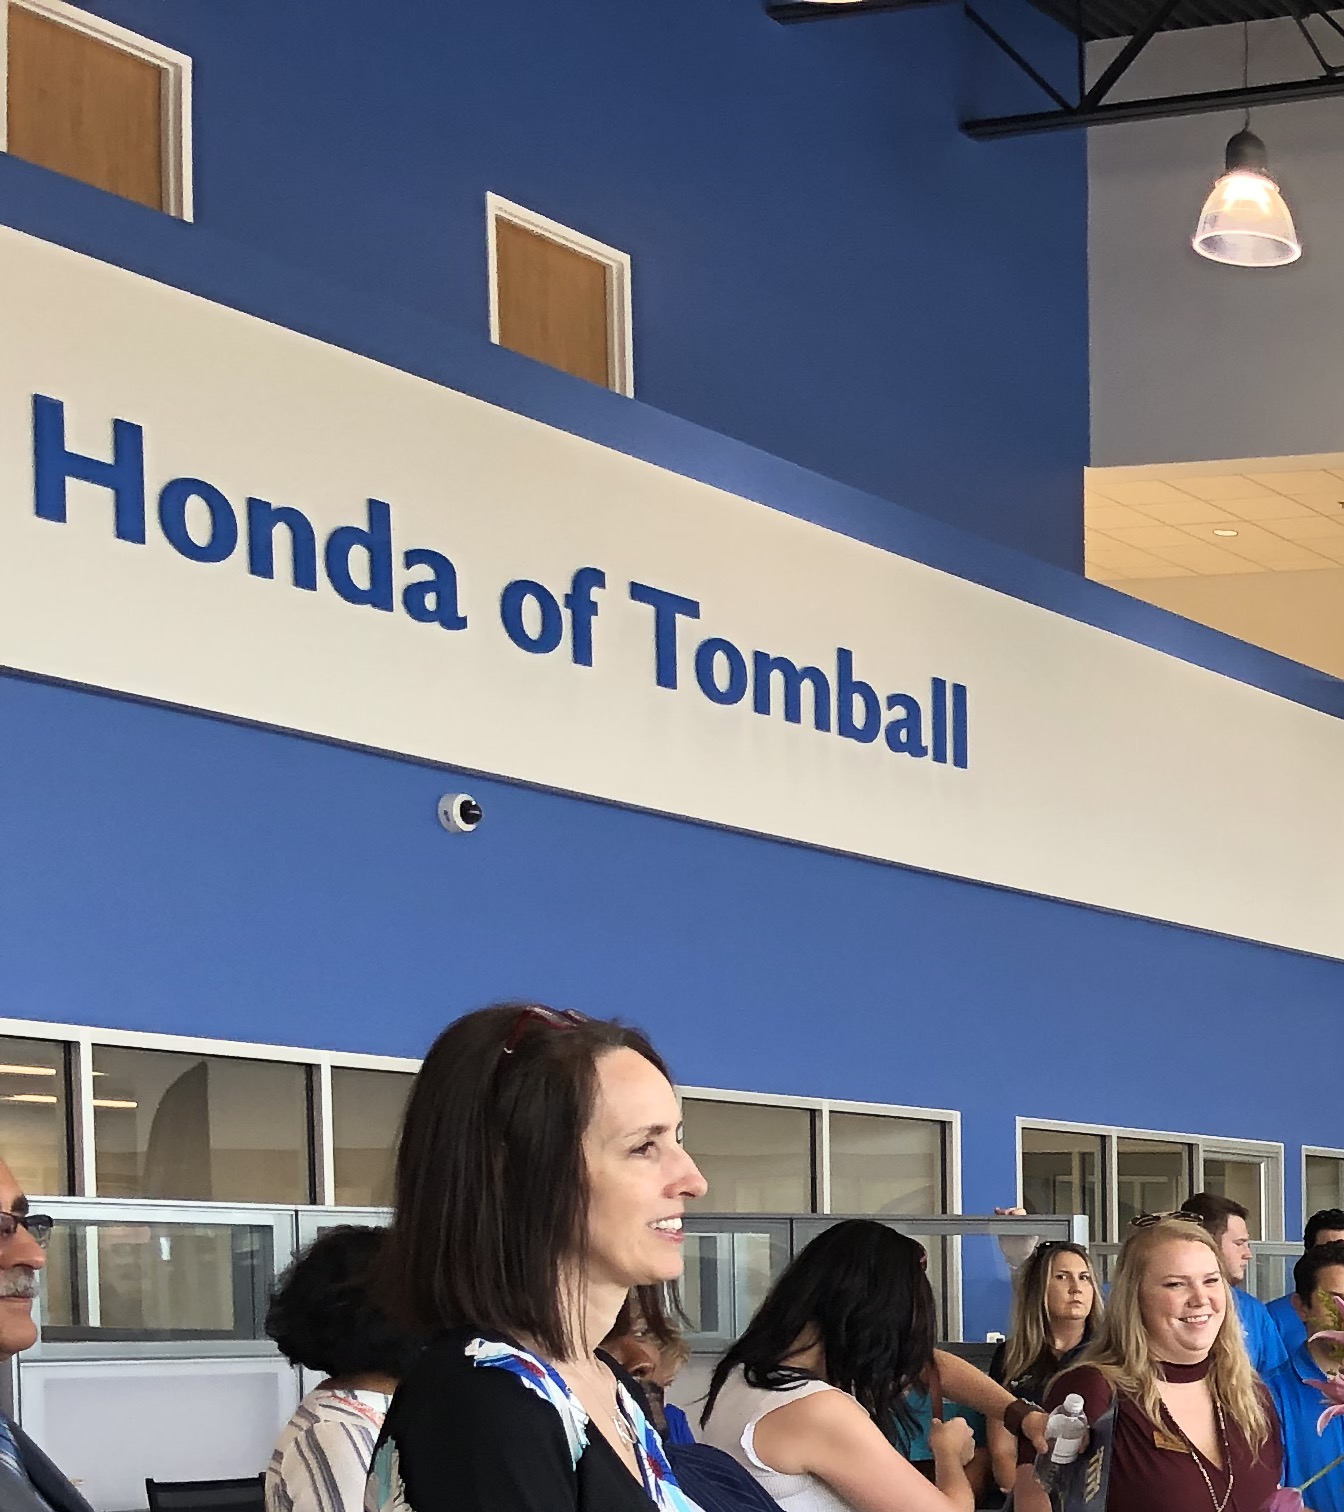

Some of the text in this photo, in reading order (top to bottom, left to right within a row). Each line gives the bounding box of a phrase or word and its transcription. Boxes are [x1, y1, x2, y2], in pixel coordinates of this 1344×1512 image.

[32, 393, 969, 770] Honda of Tomball
